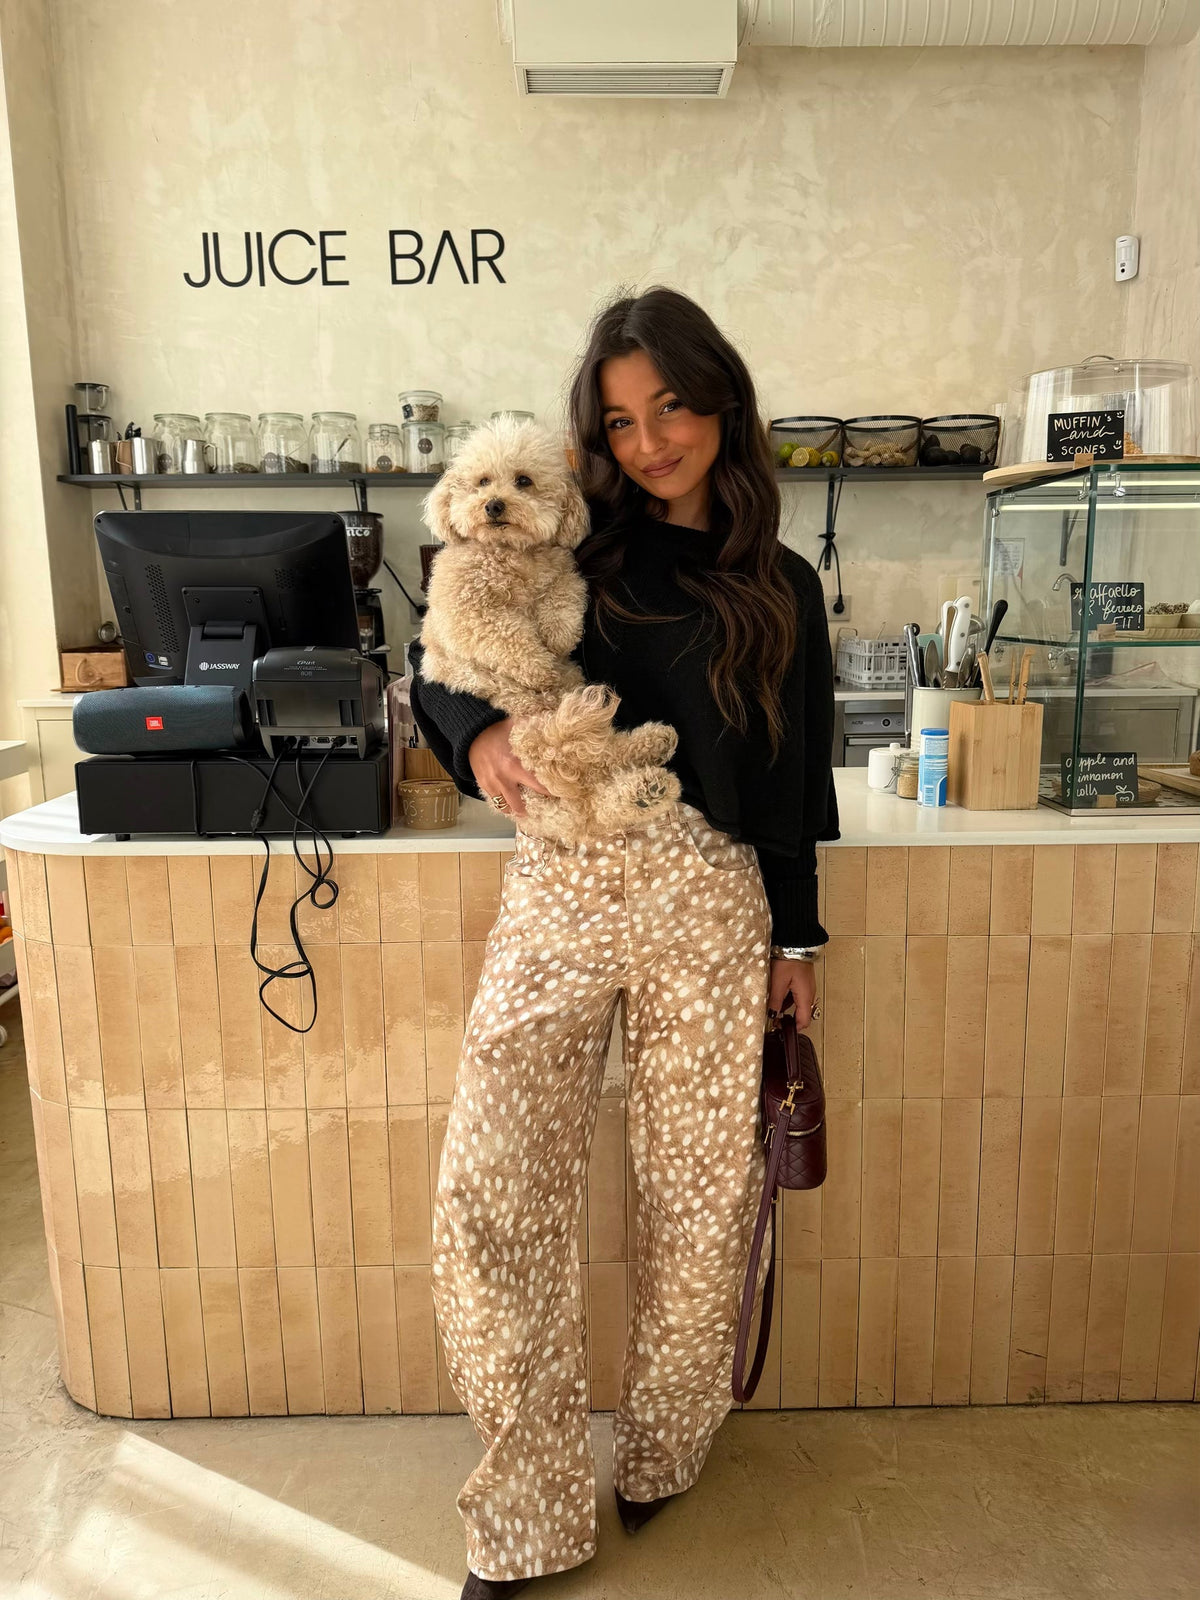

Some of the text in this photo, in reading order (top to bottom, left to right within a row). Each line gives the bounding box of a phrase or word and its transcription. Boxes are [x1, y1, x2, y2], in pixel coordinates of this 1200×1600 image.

[183, 228, 507, 288] JUICE BAR
[1059, 425, 1115, 442] and
[1061, 444, 1107, 456] SCONES
[1102, 599, 1144, 621] ferrero
[1112, 754, 1135, 767] and
